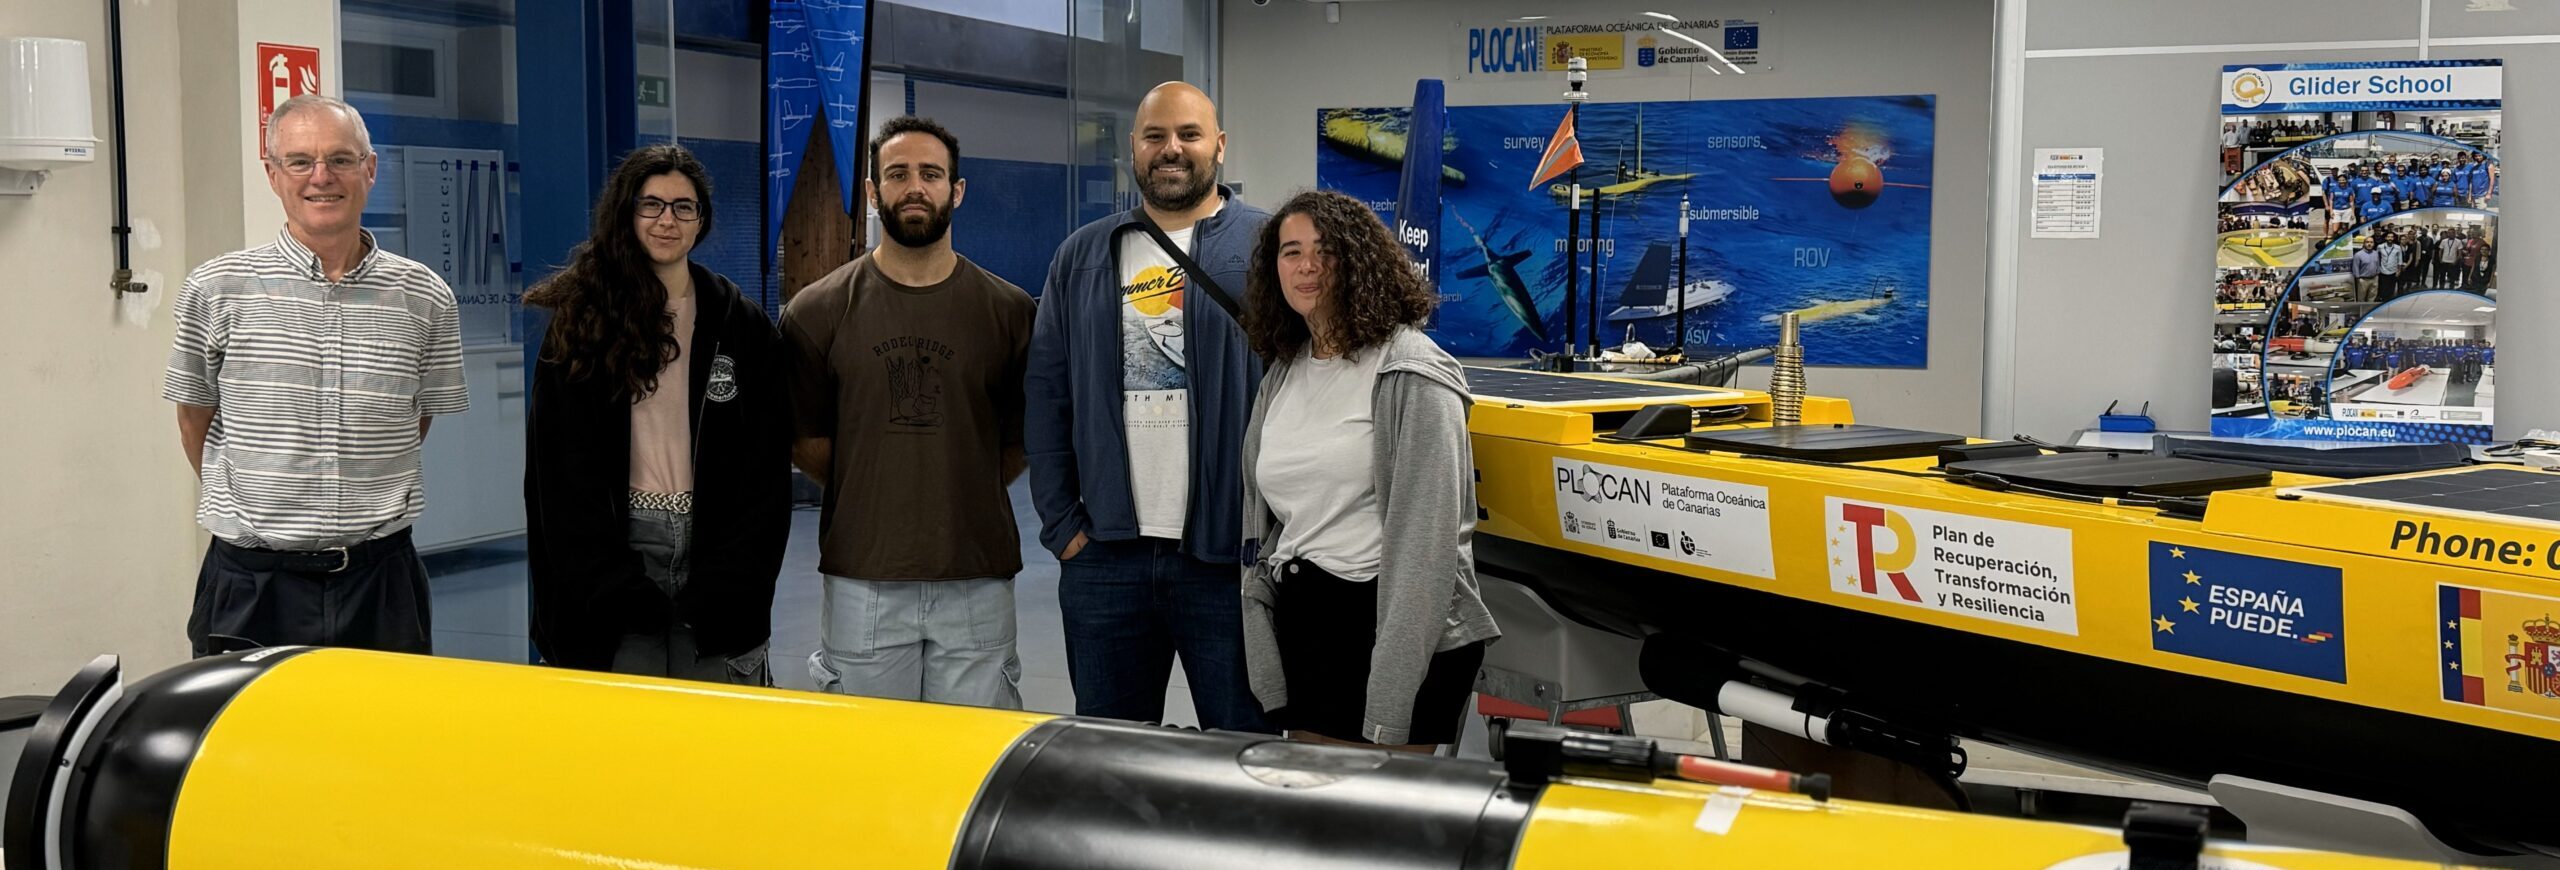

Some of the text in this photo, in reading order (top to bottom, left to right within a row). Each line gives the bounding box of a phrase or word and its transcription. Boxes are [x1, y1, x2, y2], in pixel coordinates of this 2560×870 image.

[1546, 24, 1604, 34] PLATAFORMA
[1606, 22, 1655, 33] OCEÁNICA
[1657, 21, 1669, 31] DE
[1672, 20, 1719, 30] CANARIAS
[1468, 26, 1537, 73] PLOCAN
[1658, 46, 1700, 55] Gobierno
[1658, 55, 1709, 64] de Canarias
[2289, 74, 2452, 96] Glider School
[1504, 137, 1545, 153] survey
[1708, 135, 1761, 149] sensors
[1689, 205, 1759, 221] submersible
[1399, 219, 1428, 252] Keep
[1554, 238, 1615, 258] morng
[1794, 247, 1831, 268] ROV
[1684, 329, 1710, 345] ASV
[2303, 425, 2396, 439] www.plocan.eu
[1662, 482, 1766, 510] Plataforma Oceánica
[1662, 498, 1721, 517] de Canarias
[1933, 525, 1994, 548] Plan de
[2390, 520, 2536, 567] Phone:
[1934, 547, 2058, 582] Recuperación,
[1934, 568, 2071, 605] Transformación
[1937, 592, 2045, 622] y Resiliencia
[2208, 584, 2305, 618] ESPAÑA
[2209, 606, 2298, 639] PUEDE.
